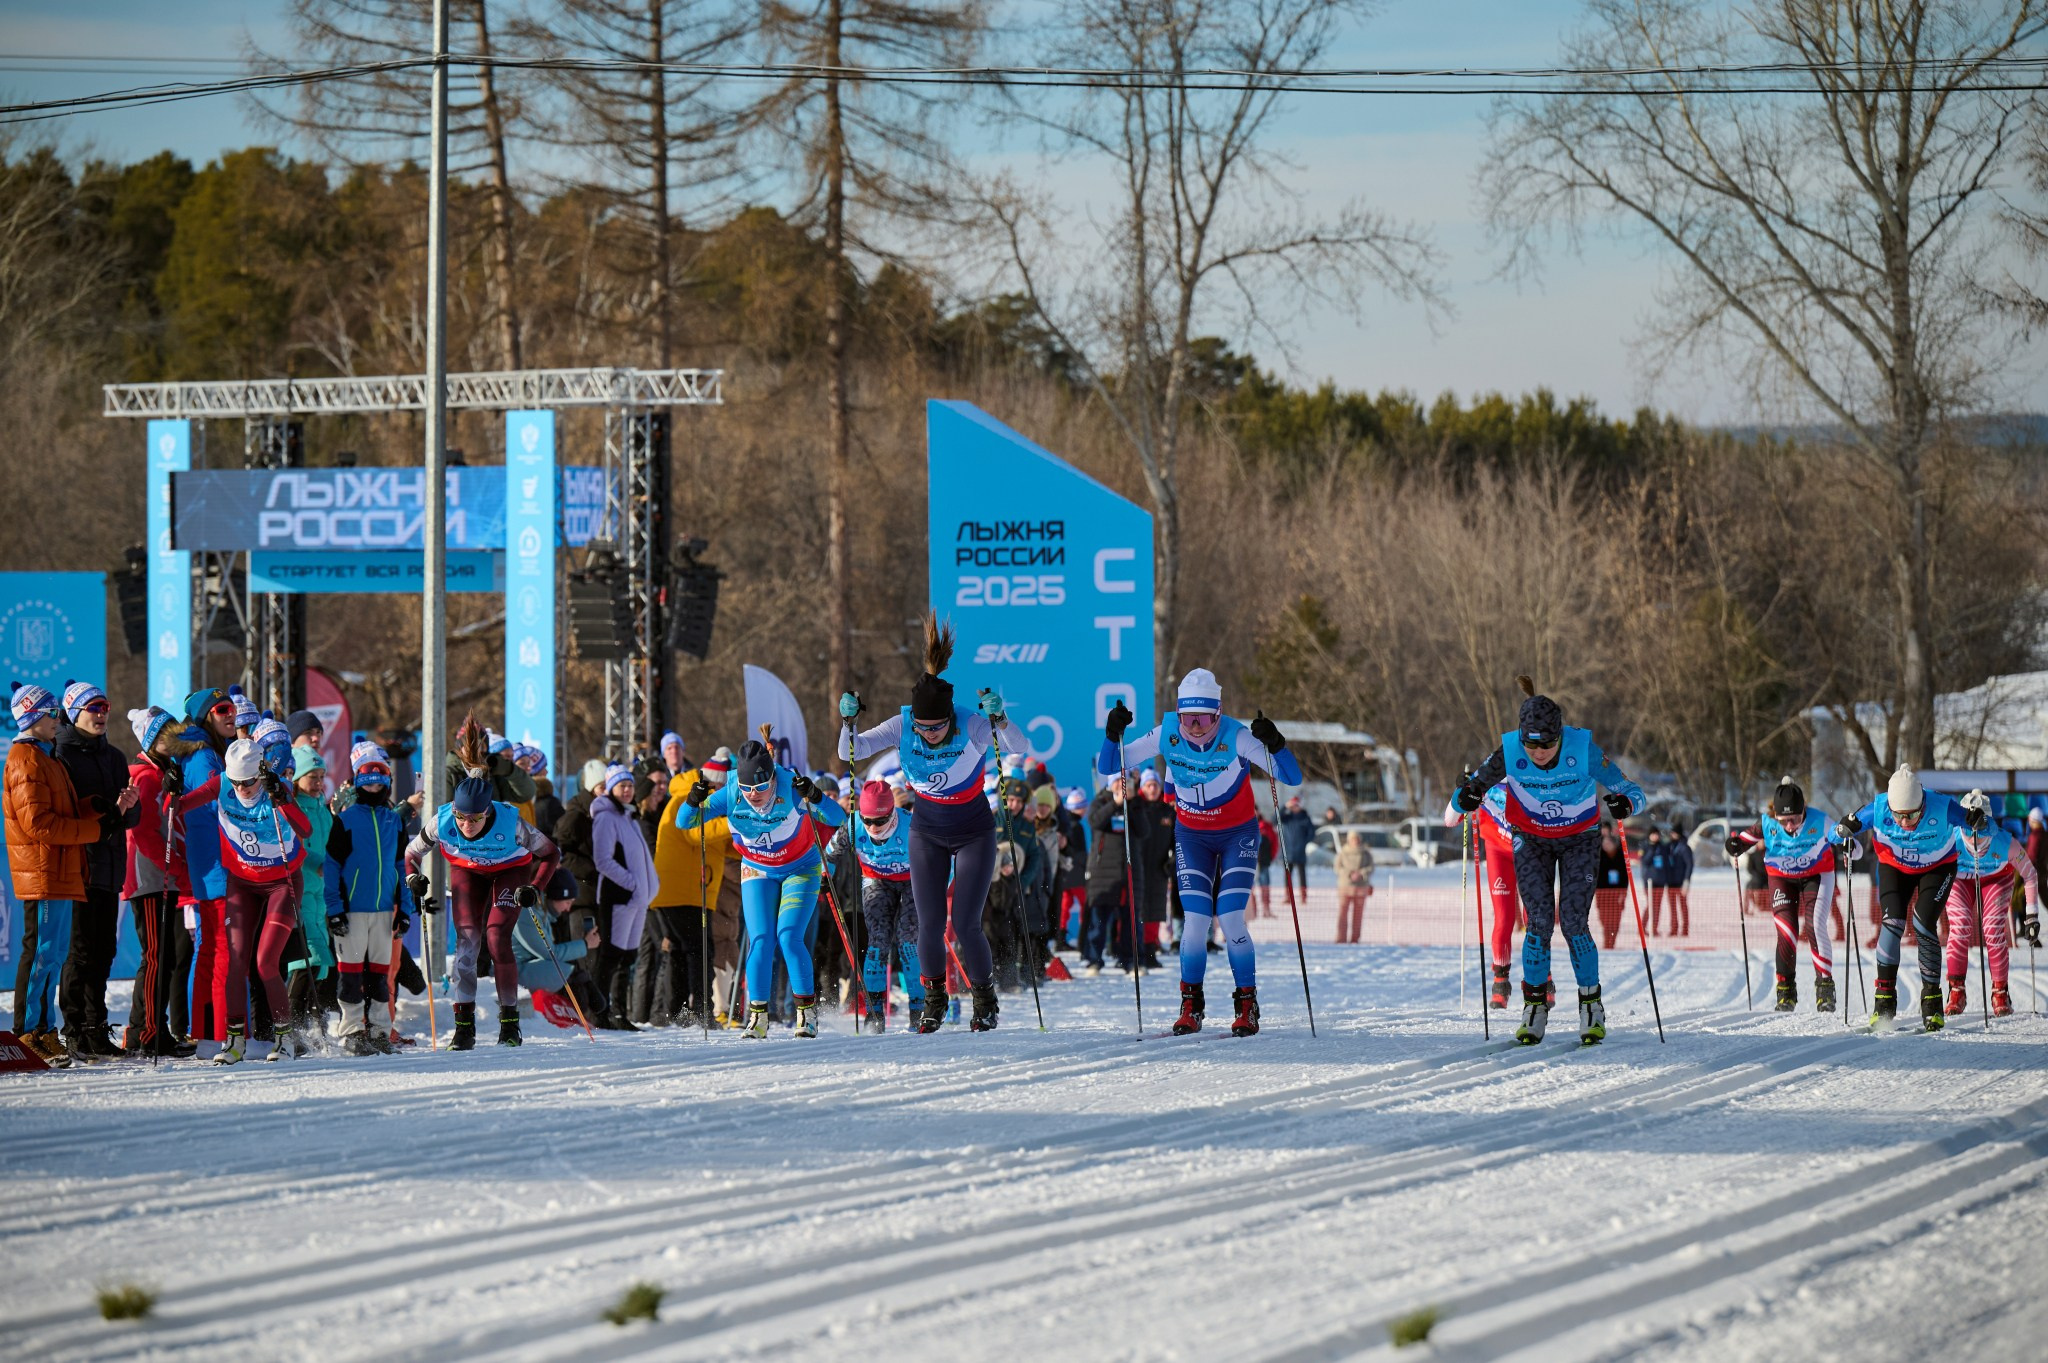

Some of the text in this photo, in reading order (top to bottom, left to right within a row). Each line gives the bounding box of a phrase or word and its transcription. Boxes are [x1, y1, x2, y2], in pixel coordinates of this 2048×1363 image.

[957, 521, 1065, 542] ЛЫЖНЯ
[956, 547, 1065, 567] РОССИИ
[268, 563, 476, 578] СТАРТУЕТ ВСЯ РОСИЯ
[955, 576, 1066, 607] 2025
[938, 749, 965, 760] РОССИИ
[1169, 759, 1229, 774] ЛЫЖНЯ РОССИИ
[927, 771, 949, 796] 2
[1519, 778, 1580, 790] ЛЫЖНЯ РОССИИ
[1190, 782, 1206, 807] 1
[1540, 799, 1564, 820] 3
[240, 829, 260, 857] 8
[755, 831, 774, 850] 4
[1901, 847, 1920, 863] 5
